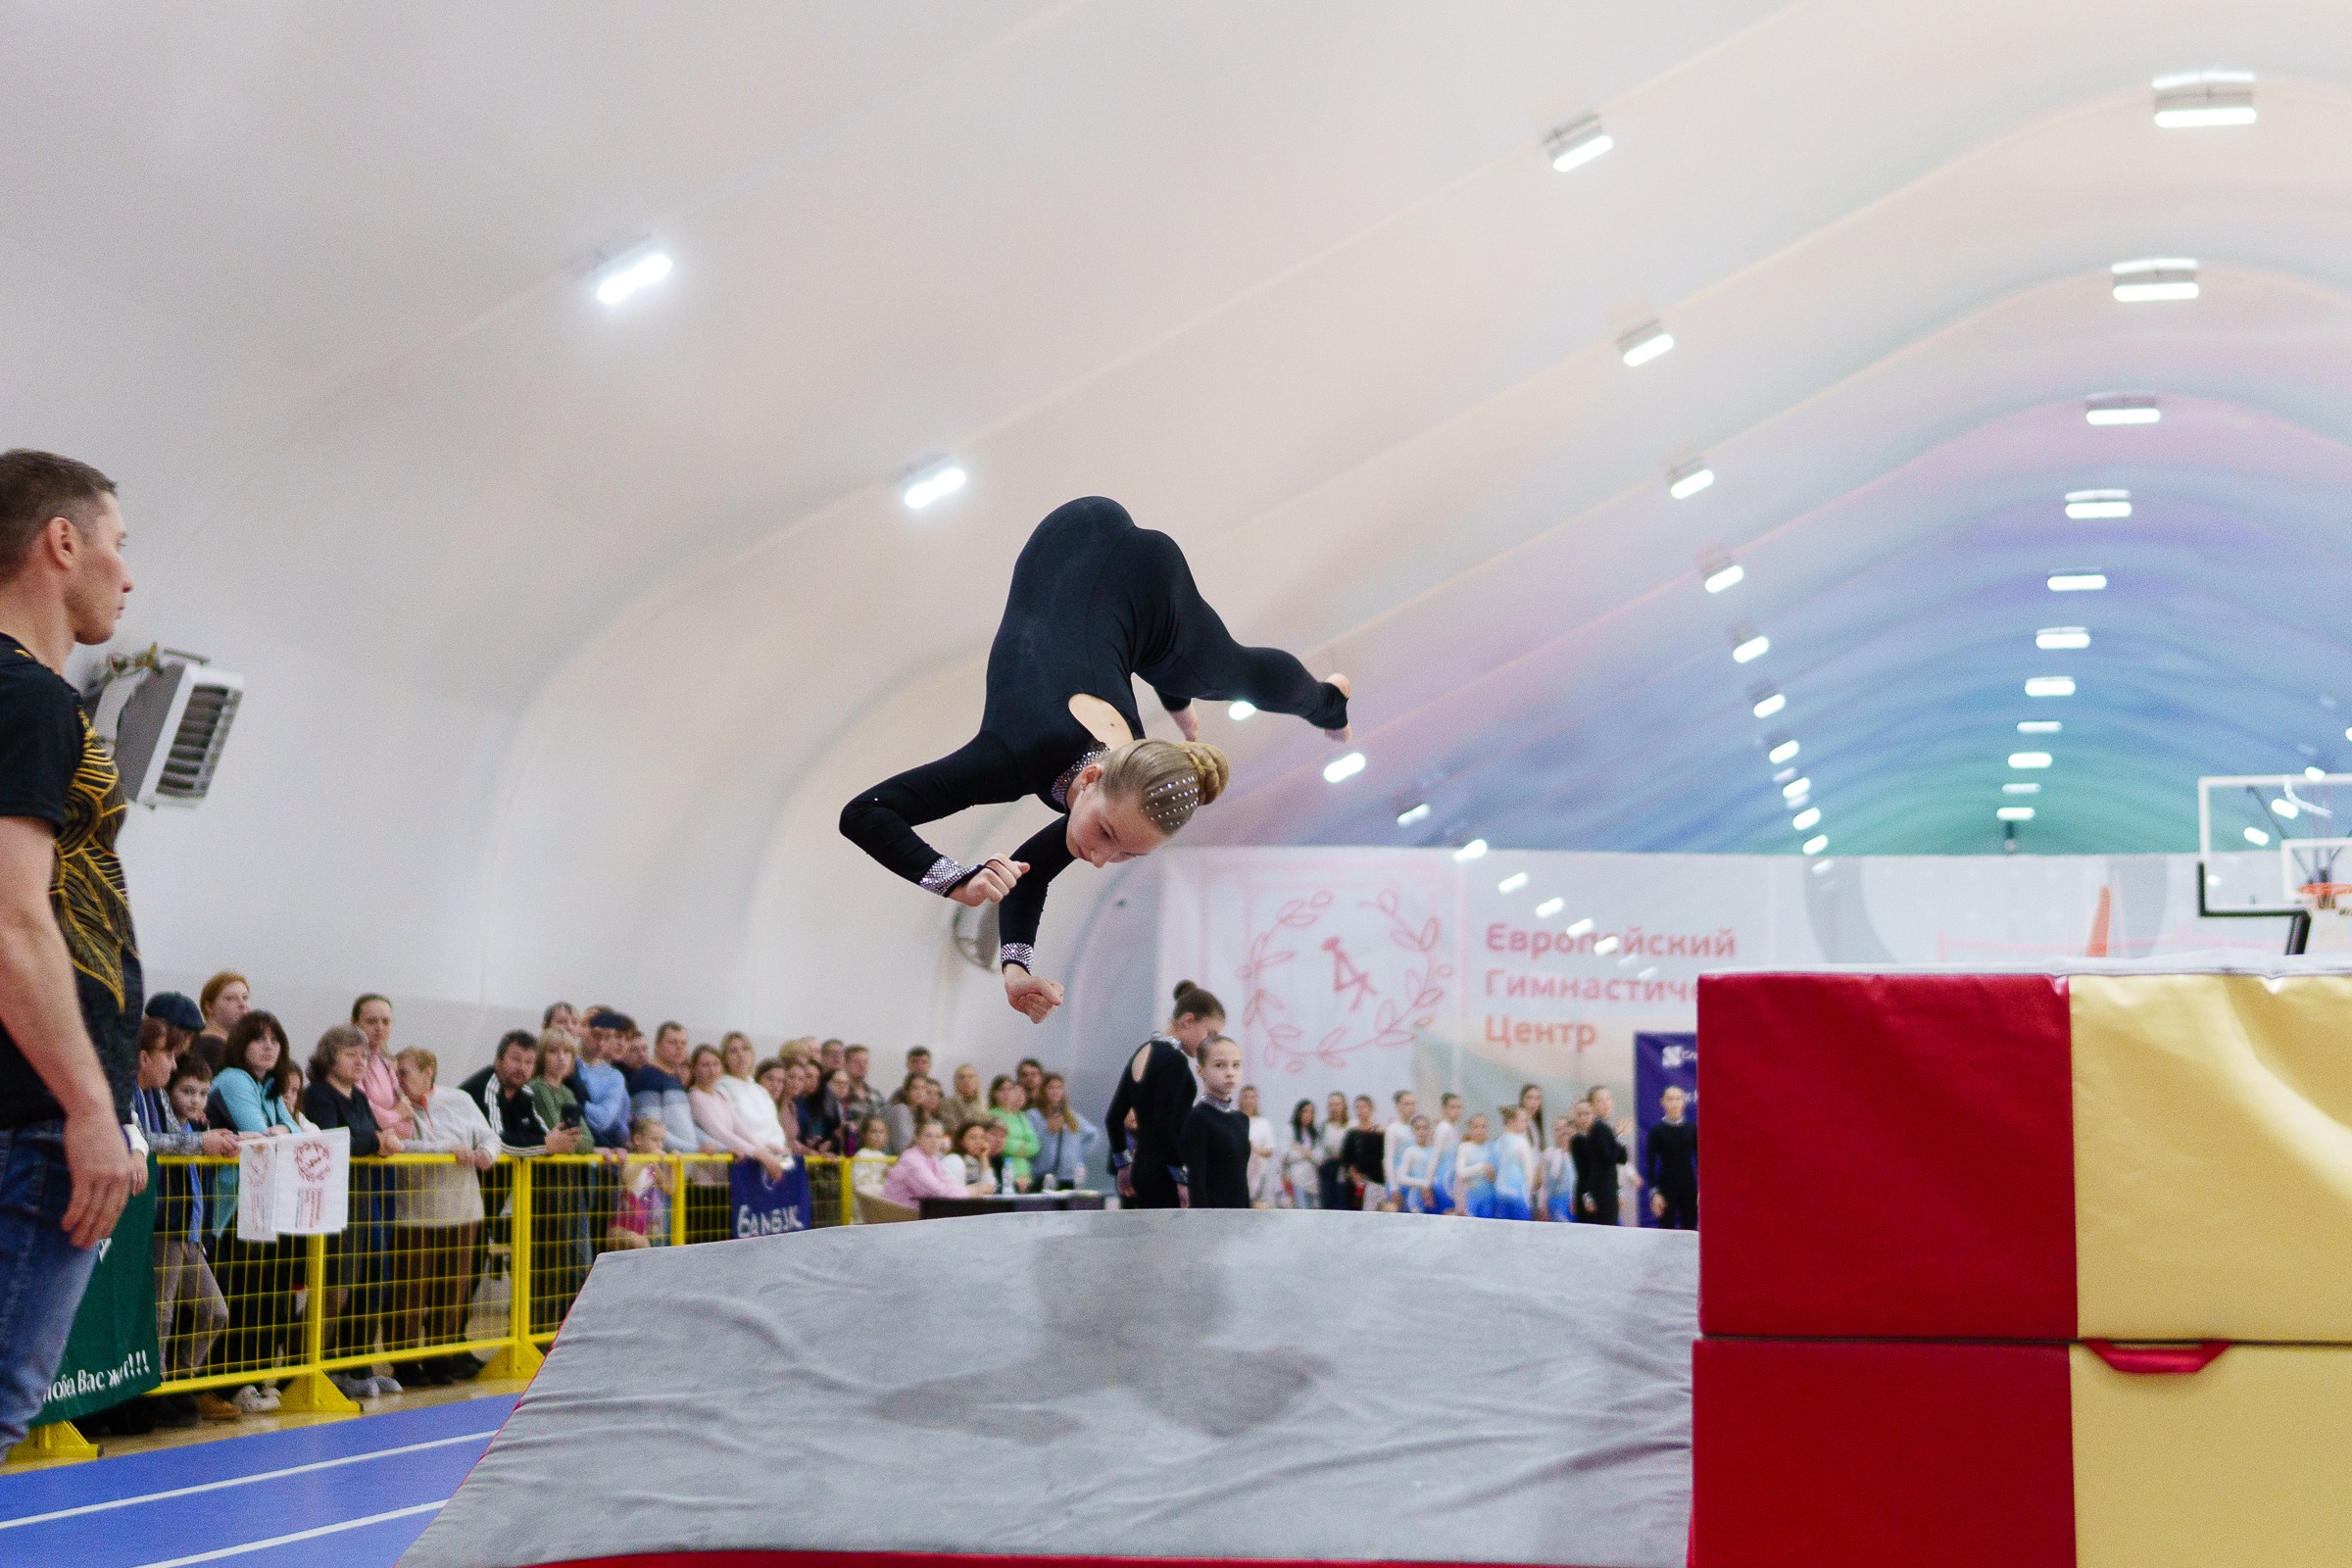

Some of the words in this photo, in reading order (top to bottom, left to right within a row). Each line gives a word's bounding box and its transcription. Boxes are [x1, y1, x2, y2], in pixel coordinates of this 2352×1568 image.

[1486, 923, 1736, 958] Европйский
[1485, 1015, 1597, 1053] Центр
[77, 1369, 106, 1394] Вас
